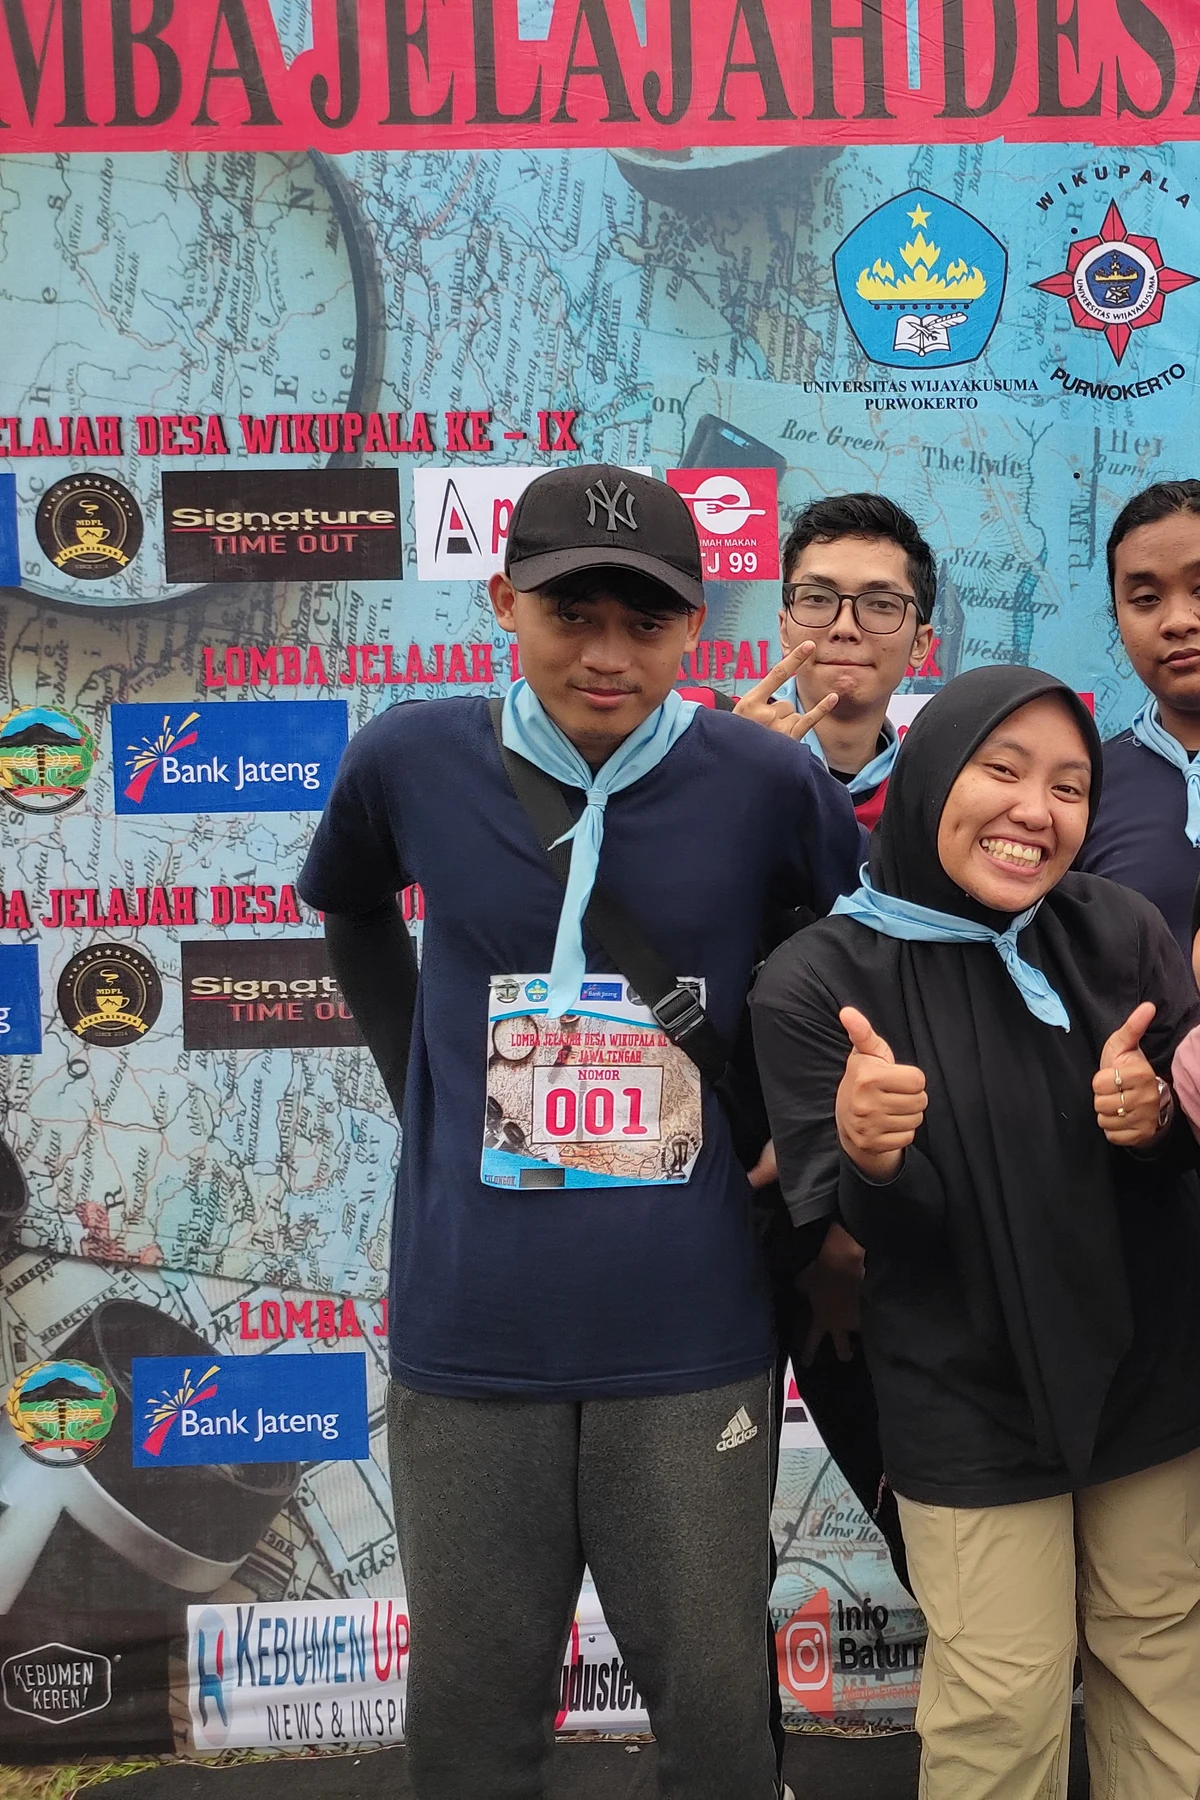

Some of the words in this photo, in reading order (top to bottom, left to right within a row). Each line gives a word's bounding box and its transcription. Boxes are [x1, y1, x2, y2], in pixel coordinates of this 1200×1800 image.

[310, 0, 897, 129] JELAJAH
[1035, 165, 1190, 212] WIKUPALA
[802, 380, 907, 394] UNIVERSITAS
[911, 379, 1038, 392] WIJAYAKUSUMA
[1050, 363, 1186, 401] PURWOKERTO
[865, 398, 978, 410] PURWOKERTO
[138, 414, 229, 455] DESA
[239, 411, 435, 454] WIKUPALA
[445, 411, 494, 452] KE
[537, 411, 579, 451] IX
[171, 507, 396, 532] Signature
[210, 534, 286, 555] TIME
[298, 533, 359, 553] OUT
[724, 539, 757, 547] MAKAN
[729, 552, 758, 573] 99
[201, 645, 329, 688] LOMBA
[339, 643, 495, 687] JELAJAH
[162, 756, 230, 784] Bank
[234, 756, 320, 791] Jateng
[41, 887, 198, 928] JELAJAH
[210, 884, 303, 926] DESA
[190, 976, 337, 1002] Signat
[227, 1003, 304, 1022] TIME
[511, 1034, 539, 1047] LOMBA
[584, 1033, 606, 1046] DESA
[610, 1033, 655, 1047] WIKUPALA
[578, 1050, 606, 1063] JAWA
[607, 1050, 642, 1063] TENGAH
[577, 1069, 621, 1081] NOMOR
[545, 1087, 648, 1136] 001
[239, 1298, 362, 1340] LOMBA
[181, 1409, 249, 1435] Bank
[254, 1408, 340, 1442] Jateng
[716, 1425, 758, 1452] adidas
[838, 1598, 888, 1631] Info
[236, 1606, 366, 1688] KEBUMEN
[13, 1662, 94, 1692] KEBUMEN
[32, 1686, 89, 1711] KEREN!
[267, 1701, 324, 1743] NEWS
[331, 1703, 345, 1738] &
